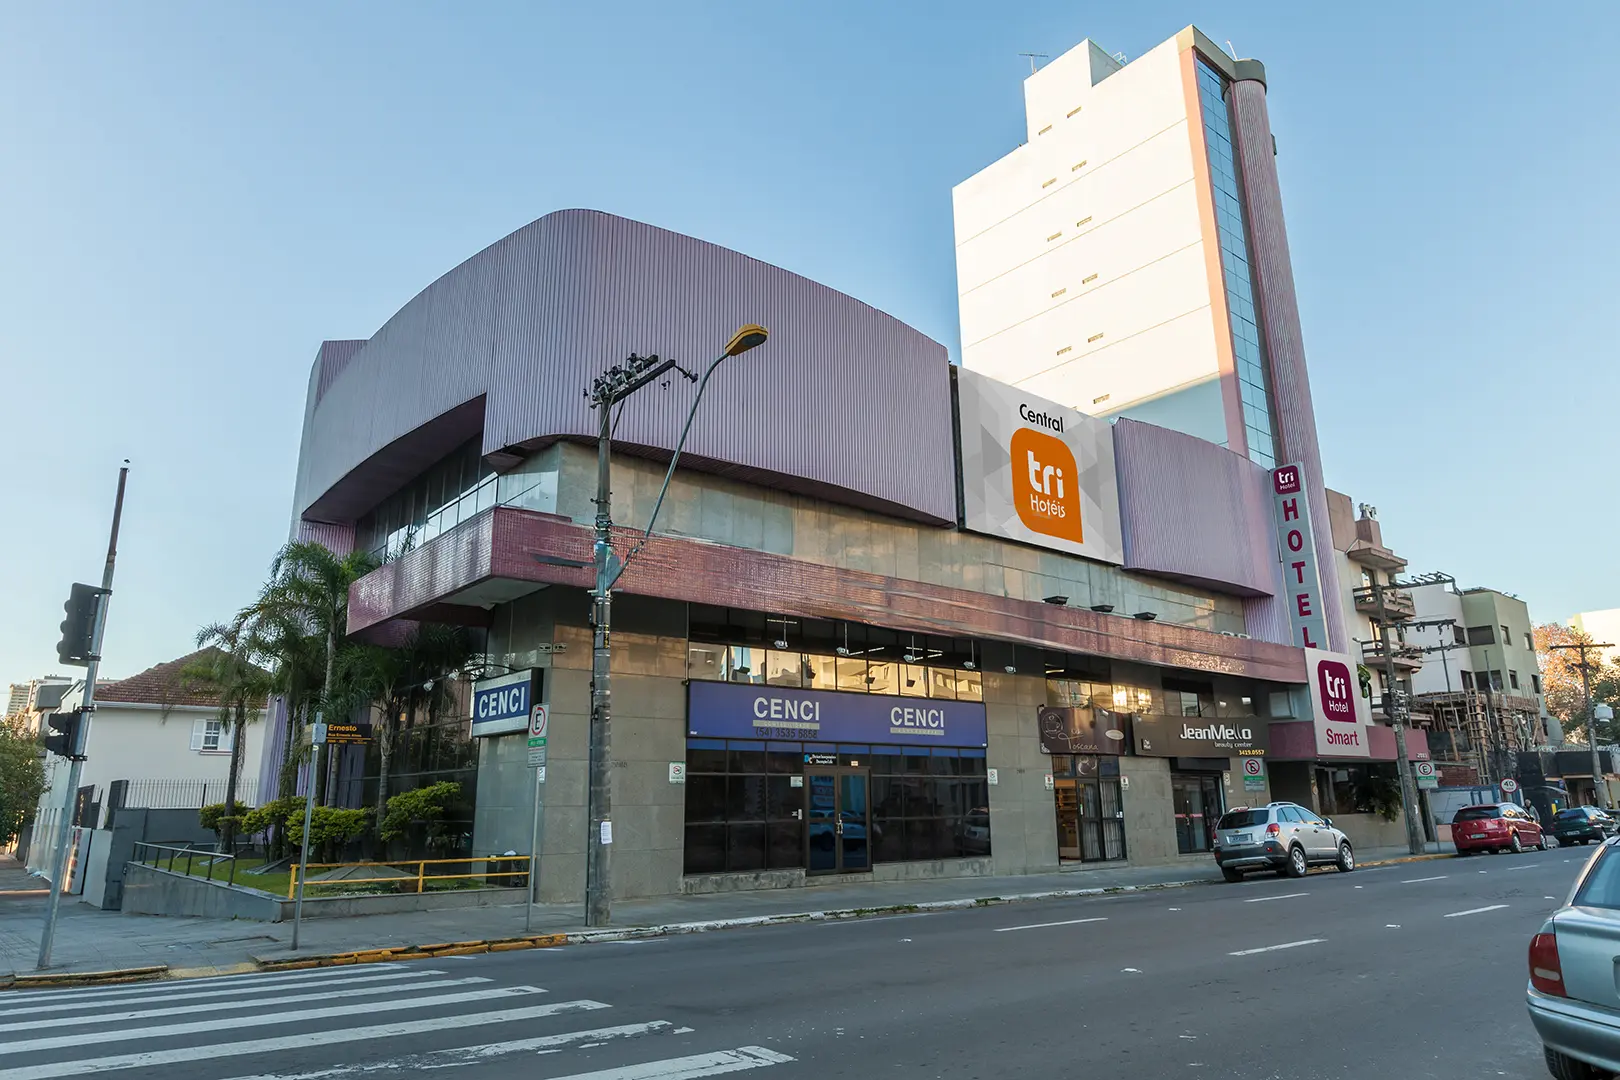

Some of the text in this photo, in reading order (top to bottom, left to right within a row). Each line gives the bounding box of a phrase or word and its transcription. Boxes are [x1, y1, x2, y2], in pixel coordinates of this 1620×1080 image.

[1019, 403, 1064, 433] Central
[1027, 449, 1065, 499] tri
[1278, 471, 1295, 484] tri
[1279, 482, 1296, 491] Hotel
[1030, 493, 1066, 518] Hotéis
[1282, 498, 1317, 648] HOTEL
[1324, 669, 1346, 699] tri
[478, 686, 525, 719] CENCI
[753, 697, 820, 721] CENCI
[1328, 700, 1349, 713] Hotel
[535, 713, 541, 730] E
[890, 707, 945, 728] CENCI
[328, 724, 357, 732] Ernesto
[755, 727, 773, 738] (54)
[775, 728, 796, 739] 3535
[1180, 723, 1252, 740] JeanMello
[1326, 728, 1360, 746] Smart
[1421, 765, 1428, 773] E
